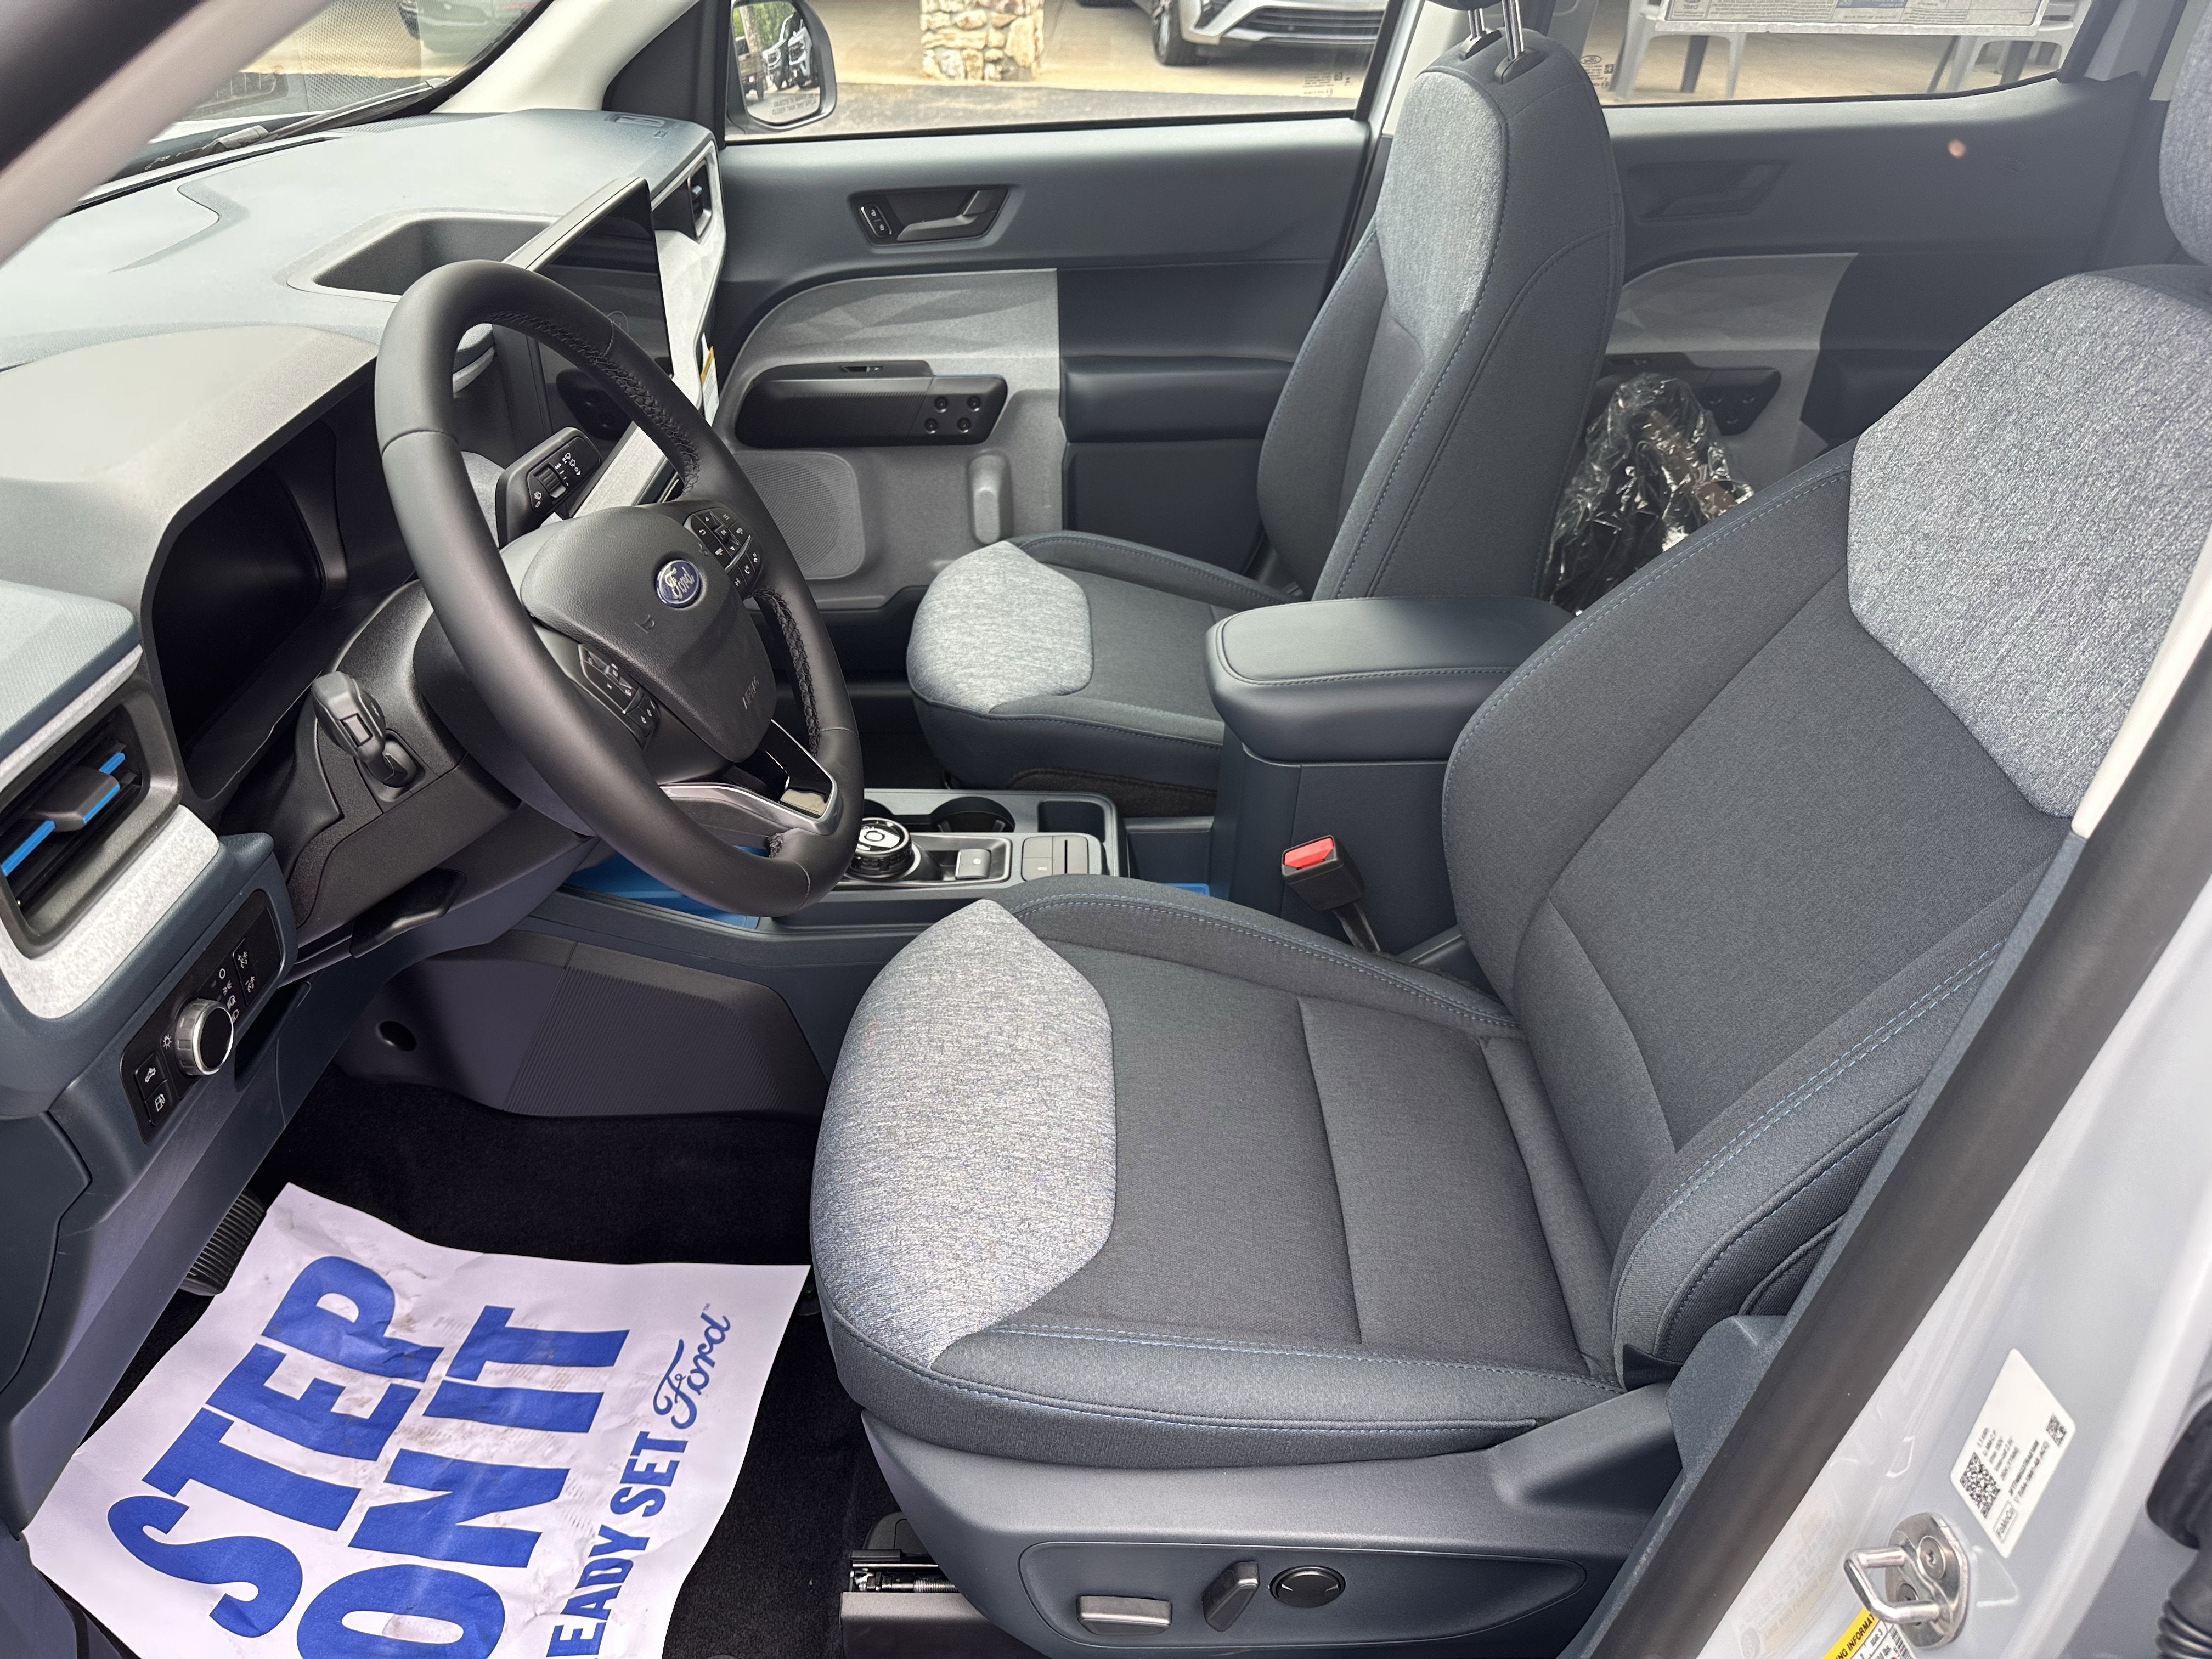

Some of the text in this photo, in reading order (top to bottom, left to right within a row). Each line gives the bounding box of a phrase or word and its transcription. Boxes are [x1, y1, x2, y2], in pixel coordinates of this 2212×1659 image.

[664, 567, 695, 599] Ford
[423, 1305, 630, 1433] IT
[108, 1256, 444, 1638] STEP
[546, 1526, 651, 1659] EADY
[610, 1431, 689, 1516] SET
[653, 1312, 731, 1430] Ford
[1995, 1507, 2015, 1538] FoMoCo
